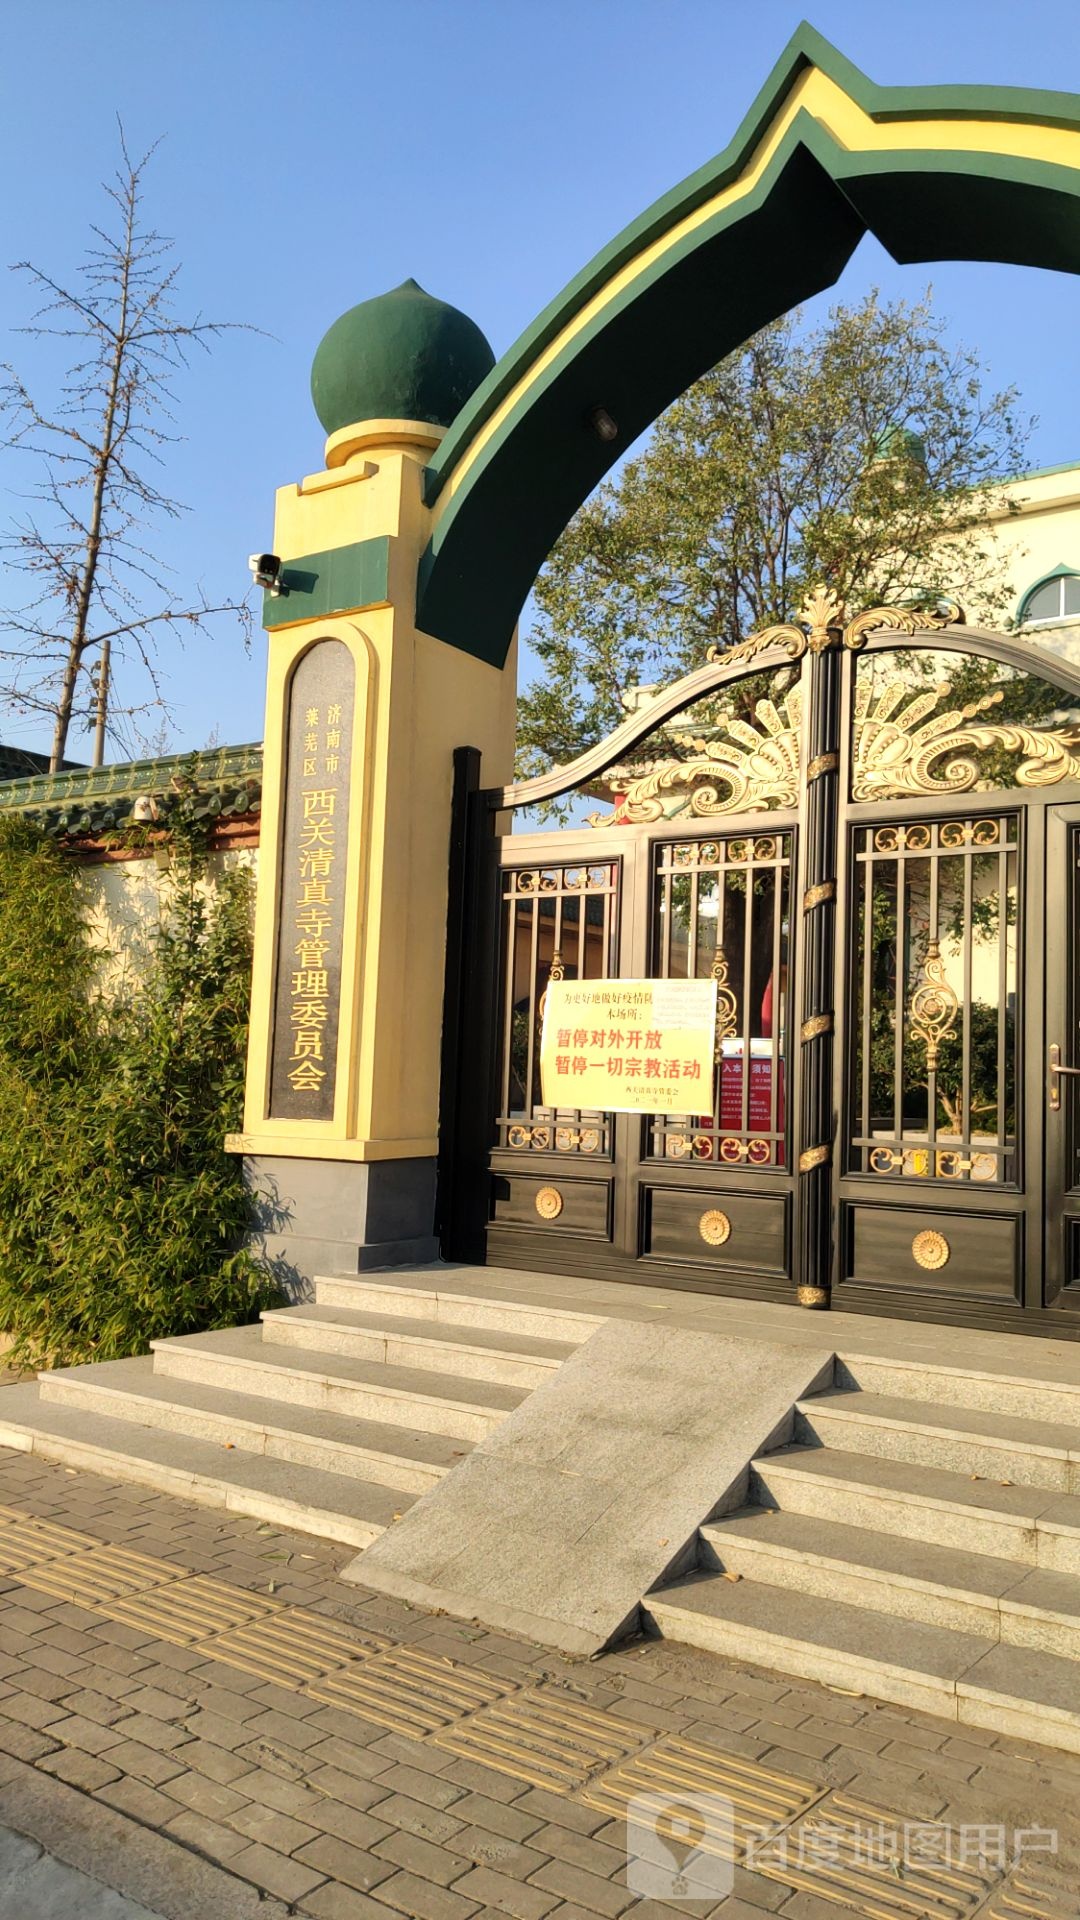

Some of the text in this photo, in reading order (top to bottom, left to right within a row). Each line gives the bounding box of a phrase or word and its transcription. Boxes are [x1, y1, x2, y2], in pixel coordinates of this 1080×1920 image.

[303, 707, 320, 777] 莱芜区
[325, 704, 342, 775] 济南市
[287, 787, 339, 1091] 西关清真寺管理委员会
[555, 1055, 701, 1080] 暂停一切宗教活动
[556, 1028, 663, 1050] 暂停对外开放
